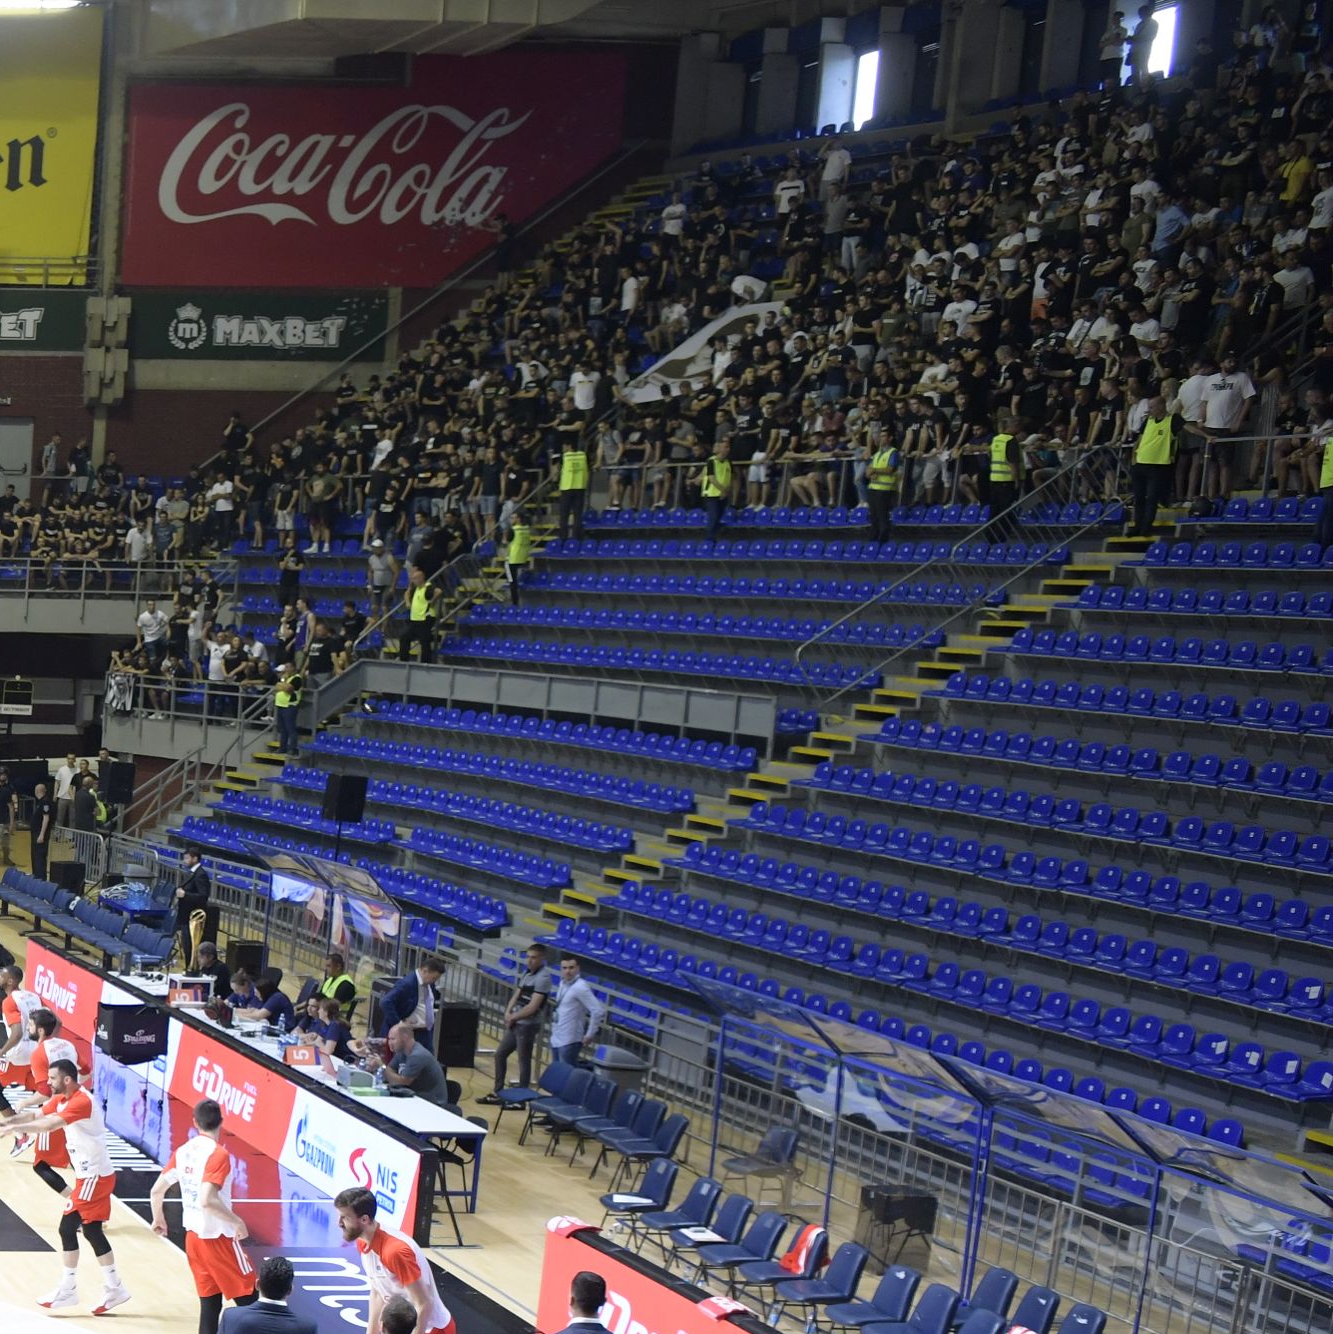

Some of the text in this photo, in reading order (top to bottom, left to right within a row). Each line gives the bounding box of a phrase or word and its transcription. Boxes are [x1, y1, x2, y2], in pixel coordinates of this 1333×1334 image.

[158, 102, 532, 226] Coca-Cola
[123, 1034, 156, 1043] SPALDING
[376, 1163, 398, 1194] NIS
